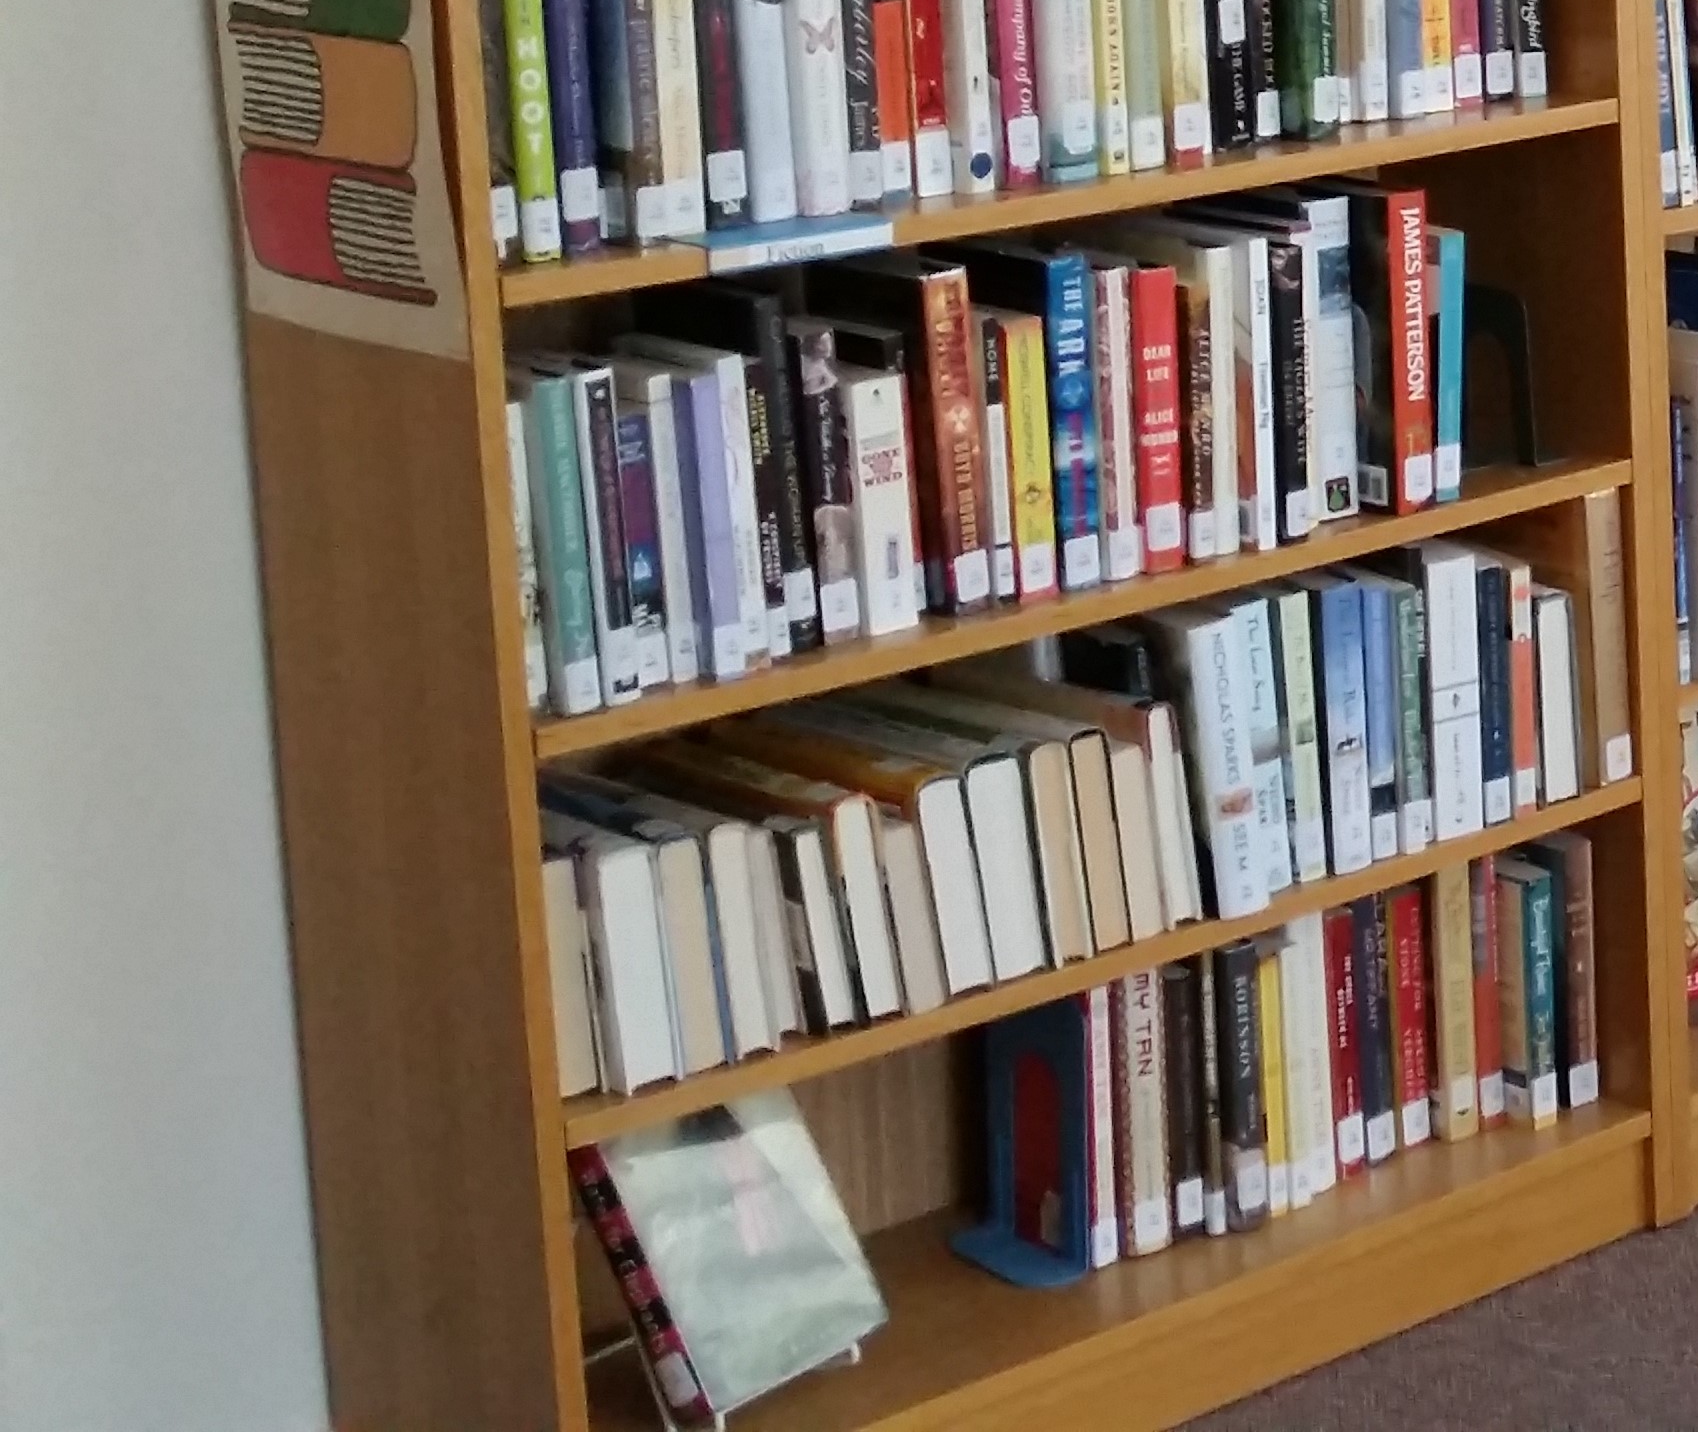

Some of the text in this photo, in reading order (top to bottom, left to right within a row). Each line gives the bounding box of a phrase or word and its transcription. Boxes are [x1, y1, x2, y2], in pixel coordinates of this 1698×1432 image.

[1013, 67, 1031, 84] of
[1107, 44, 1122, 92] AGAIN
[1056, 276, 1086, 379] THE ARK
[1399, 207, 1426, 402] JAMES PATTERSON
[985, 339, 999, 383] HOME
[1143, 345, 1171, 360] DEAR
[1146, 365, 1170, 383] LIFE
[1197, 328, 1211, 375] ALICE
[1211, 632, 1247, 853] NICHOLAS SPARKS SEE
[1137, 1019, 1152, 1077] TAN
[1233, 975, 1252, 1080] ROBINSON
